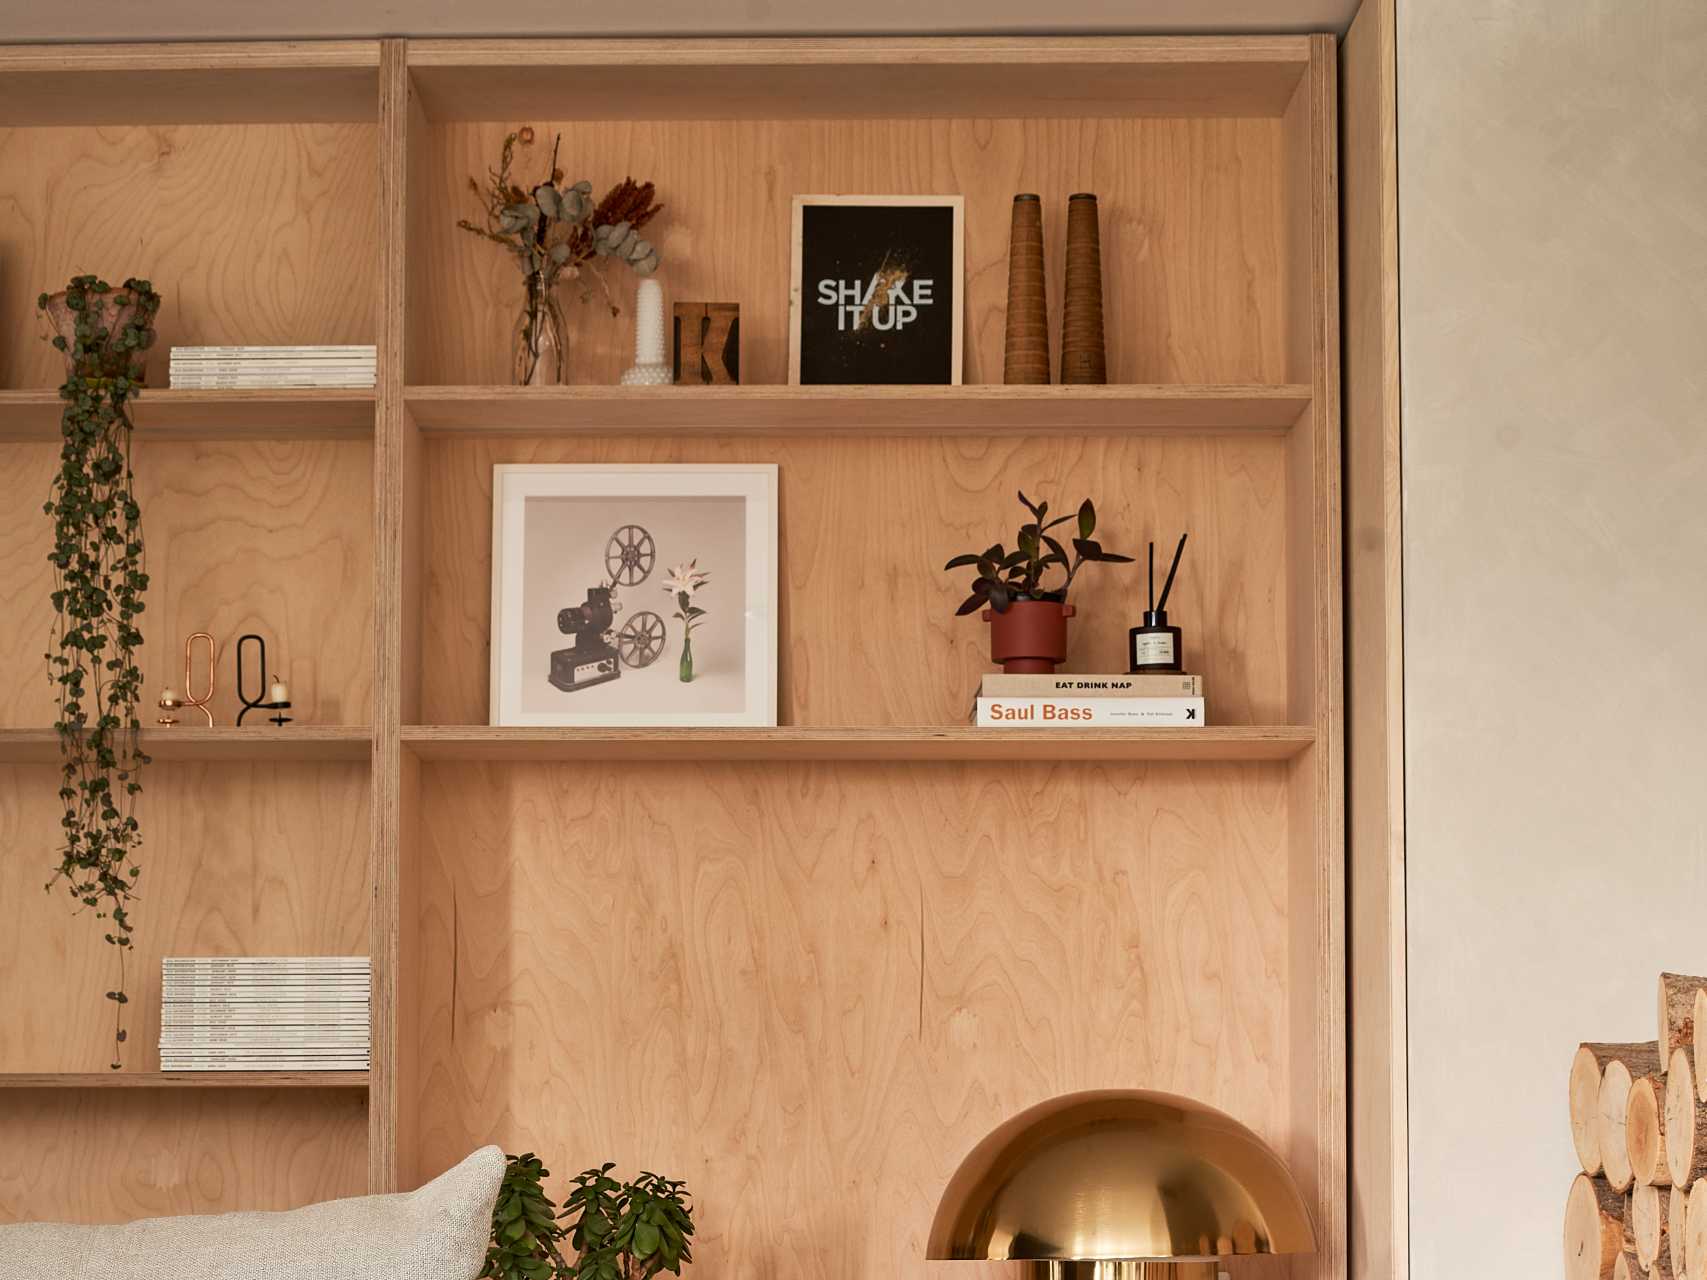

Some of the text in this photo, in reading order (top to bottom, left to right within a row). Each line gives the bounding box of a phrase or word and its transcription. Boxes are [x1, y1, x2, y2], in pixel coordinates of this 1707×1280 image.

[817, 272, 934, 305] SHAKE
[838, 304, 918, 331] IT UP
[674, 303, 739, 385] K
[1055, 681, 1133, 689] EAT DRINK NAP
[990, 703, 1093, 721] Saul Bass
